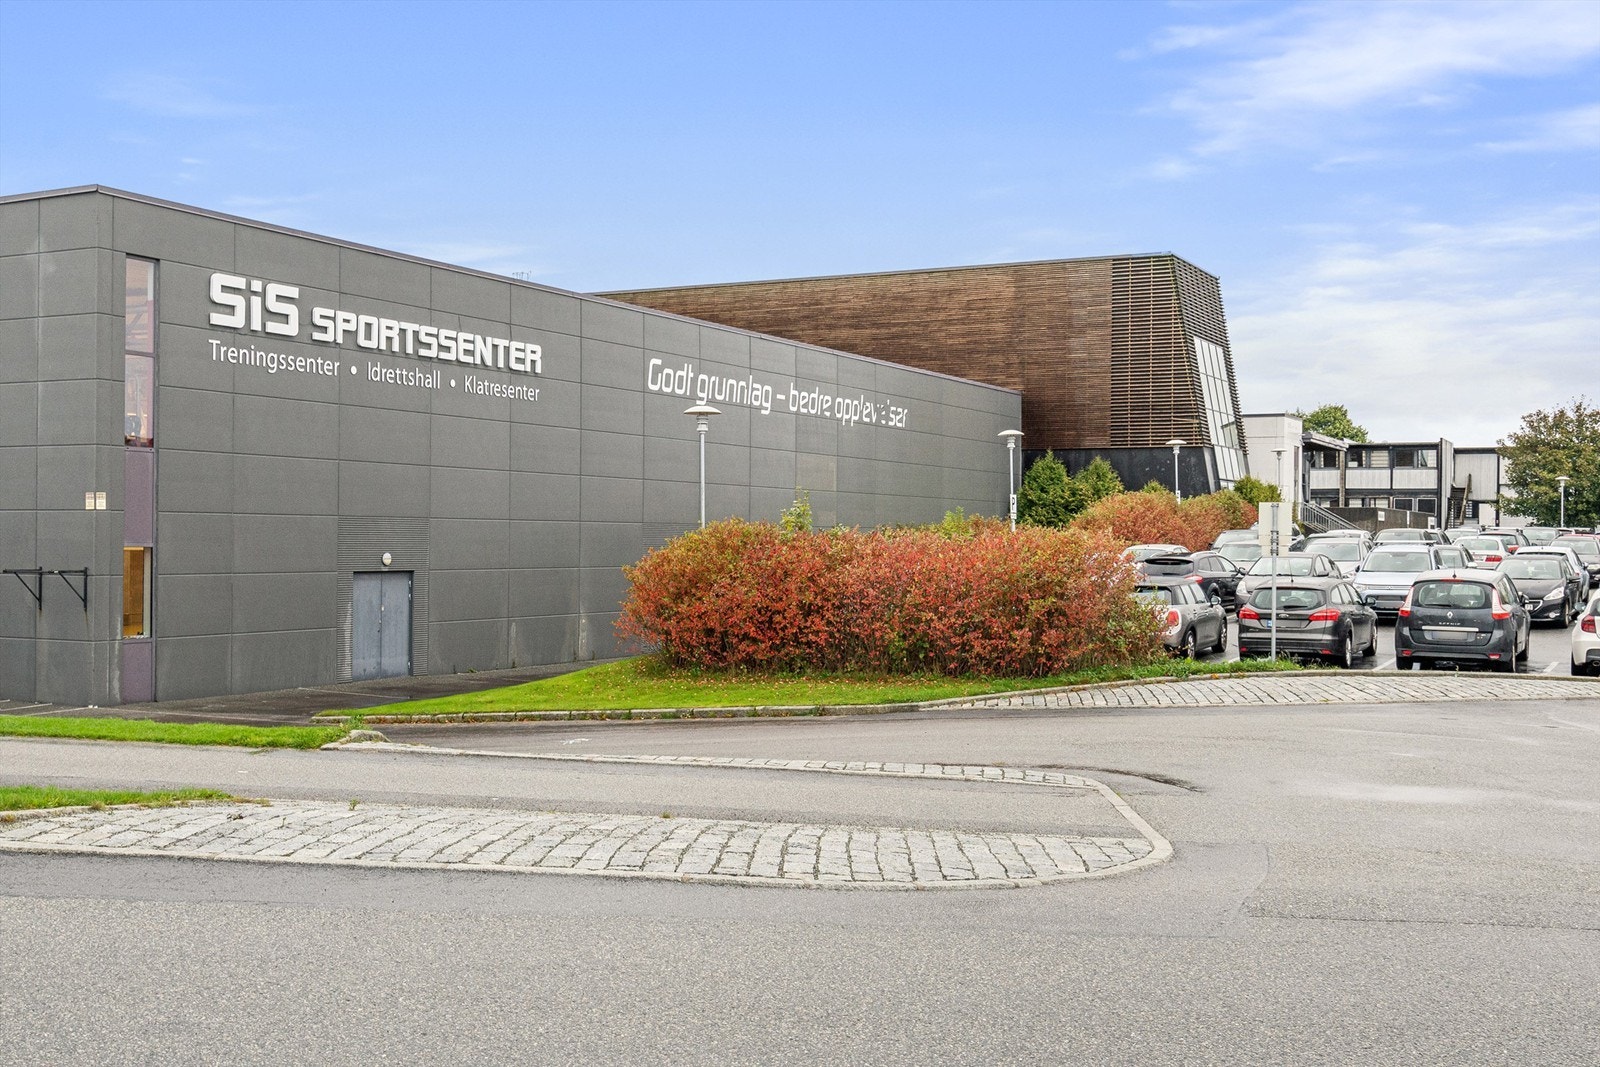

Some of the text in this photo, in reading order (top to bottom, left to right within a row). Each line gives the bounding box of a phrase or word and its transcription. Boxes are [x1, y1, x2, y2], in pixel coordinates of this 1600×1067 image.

[209, 272, 543, 374] SiS SPORTSSENTER
[208, 338, 540, 402] Treningssenter Idrettshall Klatresenter
[647, 357, 695, 396] Godt
[696, 373, 773, 416] grunnlag
[788, 381, 832, 418] bedre
